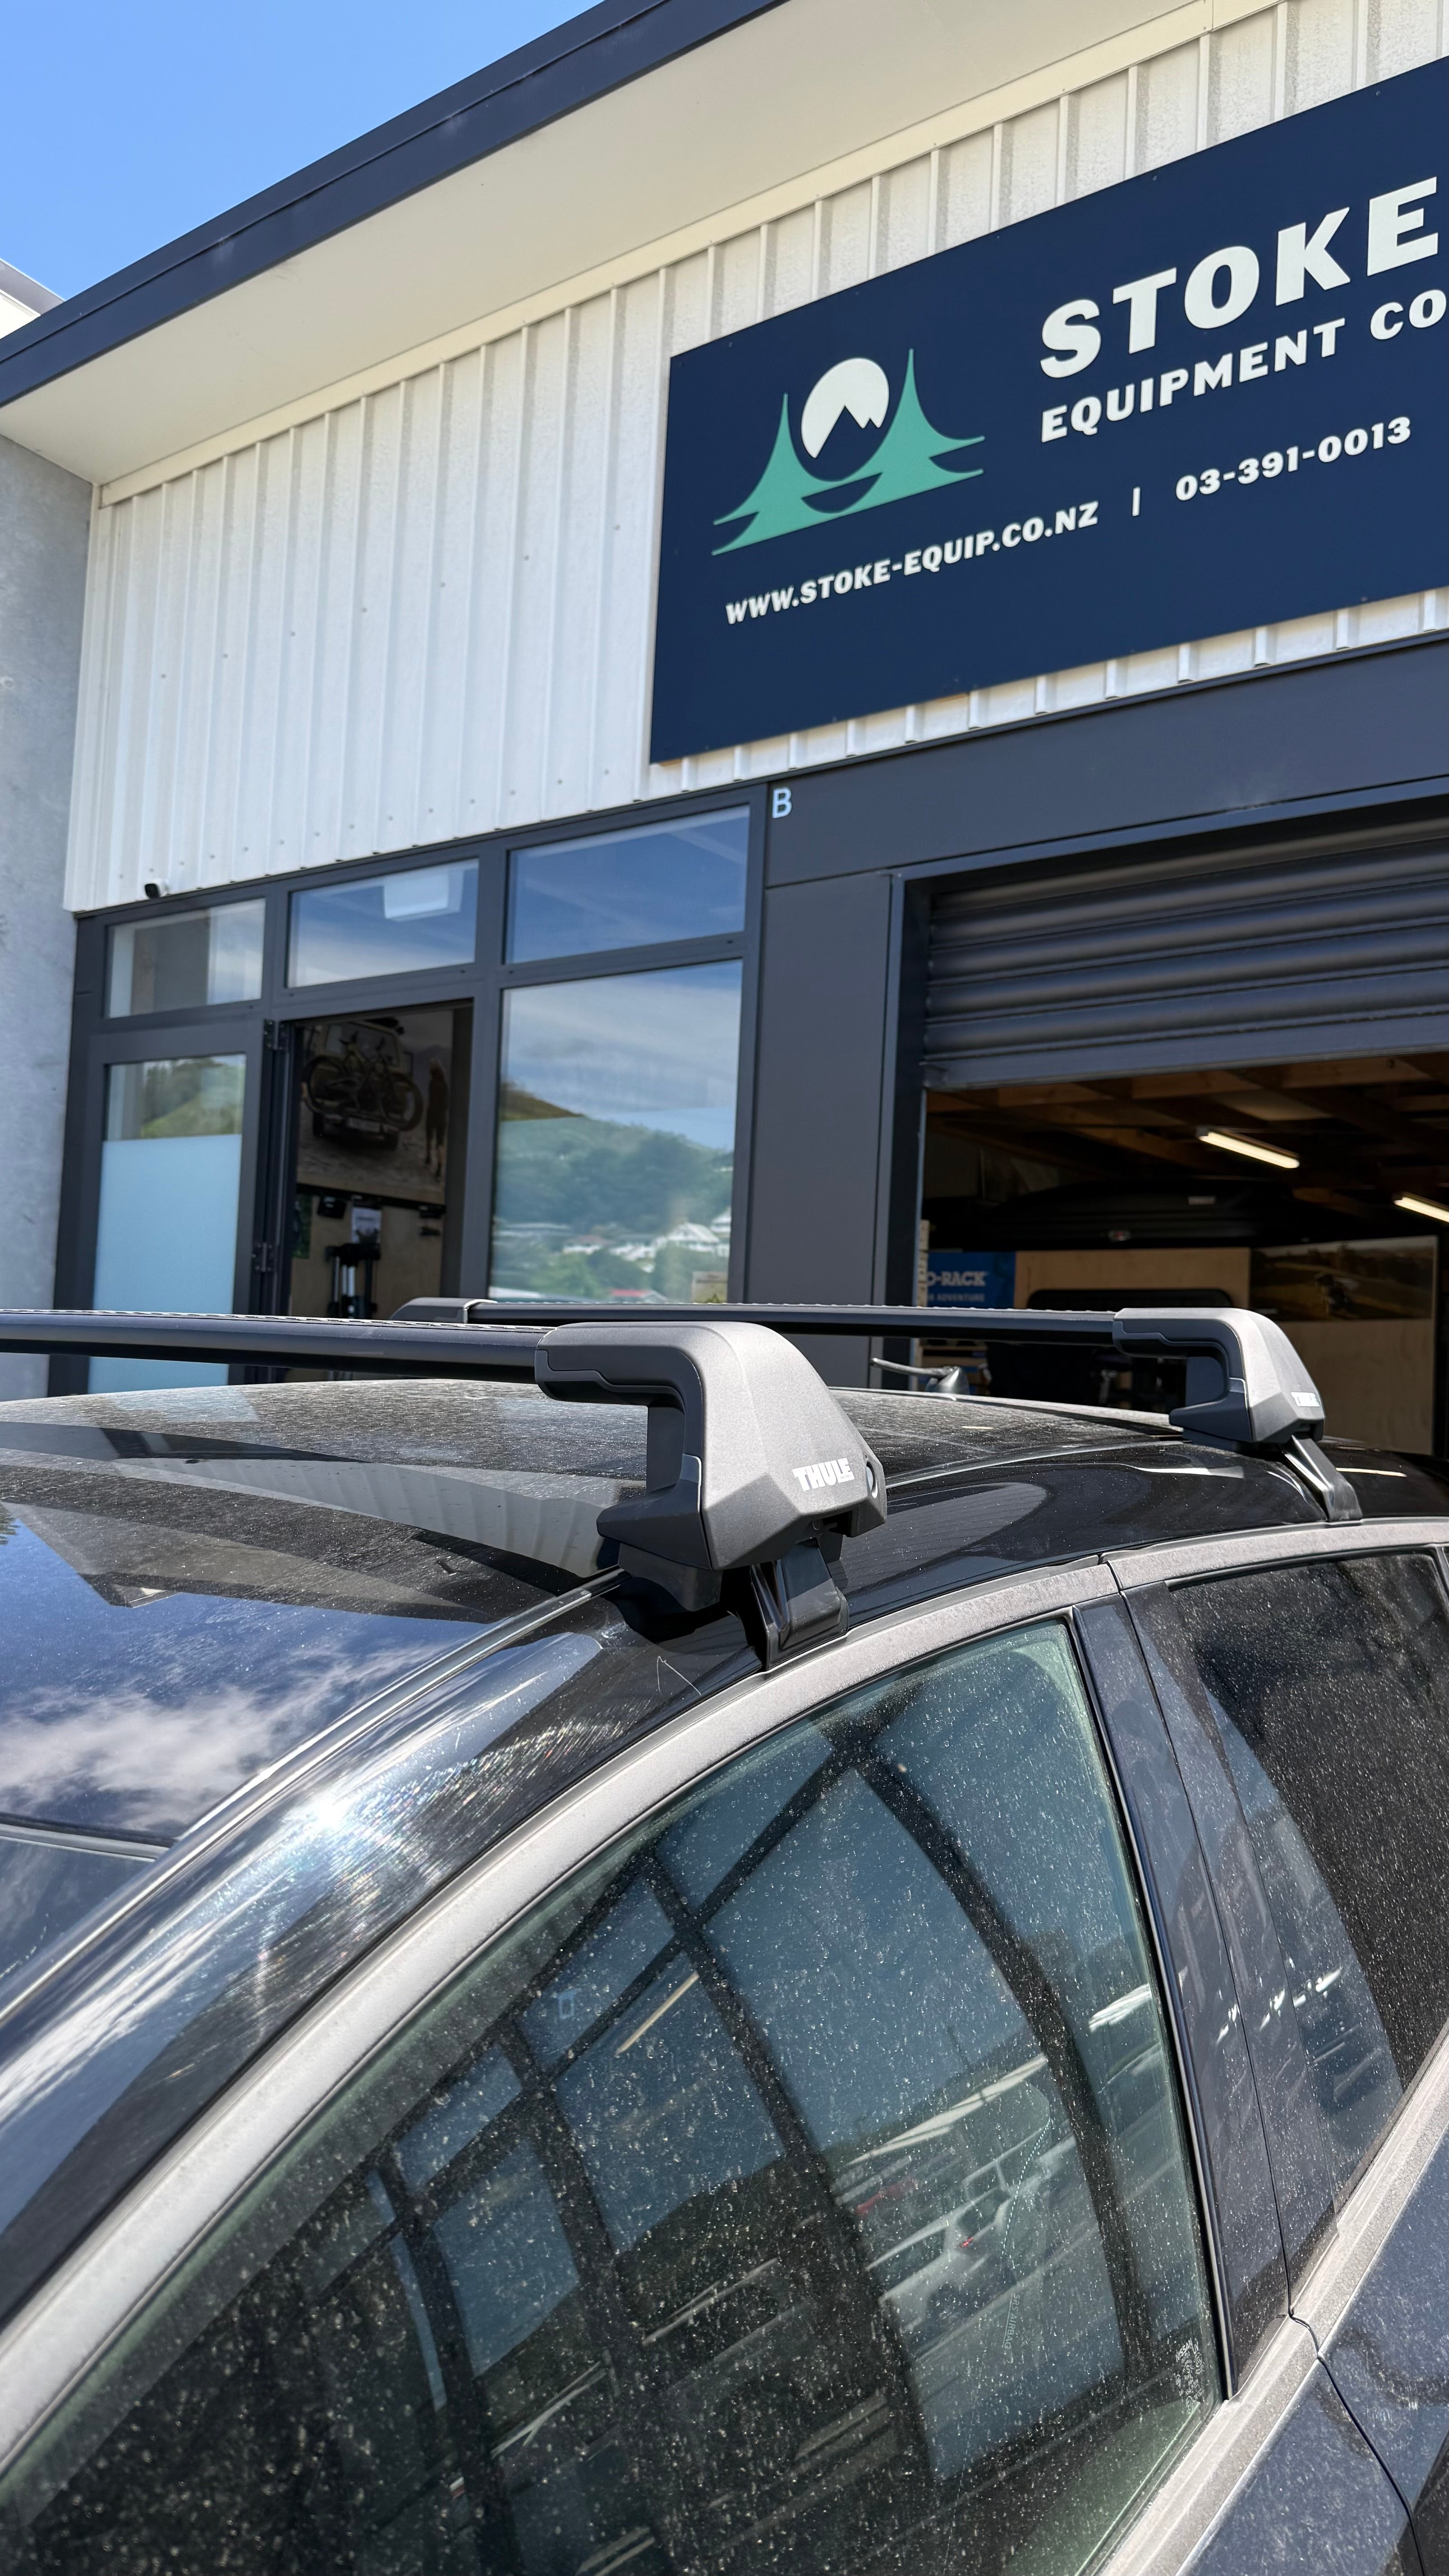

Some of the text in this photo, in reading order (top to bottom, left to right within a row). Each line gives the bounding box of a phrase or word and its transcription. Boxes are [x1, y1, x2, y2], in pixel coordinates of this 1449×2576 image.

[1040, 176, 1439, 378] STOKE
[1041, 289, 1447, 443] EQUIPMENT CO
[725, 501, 1099, 625] WWW.STOKE-EQUIP.CO.NZ
[1175, 416, 1411, 501] 03-391-0013
[772, 788, 792, 819] B
[936, 1293, 985, 1302] ADVENTURE
[792, 1457, 855, 1491] THULE
[1003, 2293, 1021, 2350] SRS AIRBAG
[1175, 2337, 1193, 2363] NISSAN
